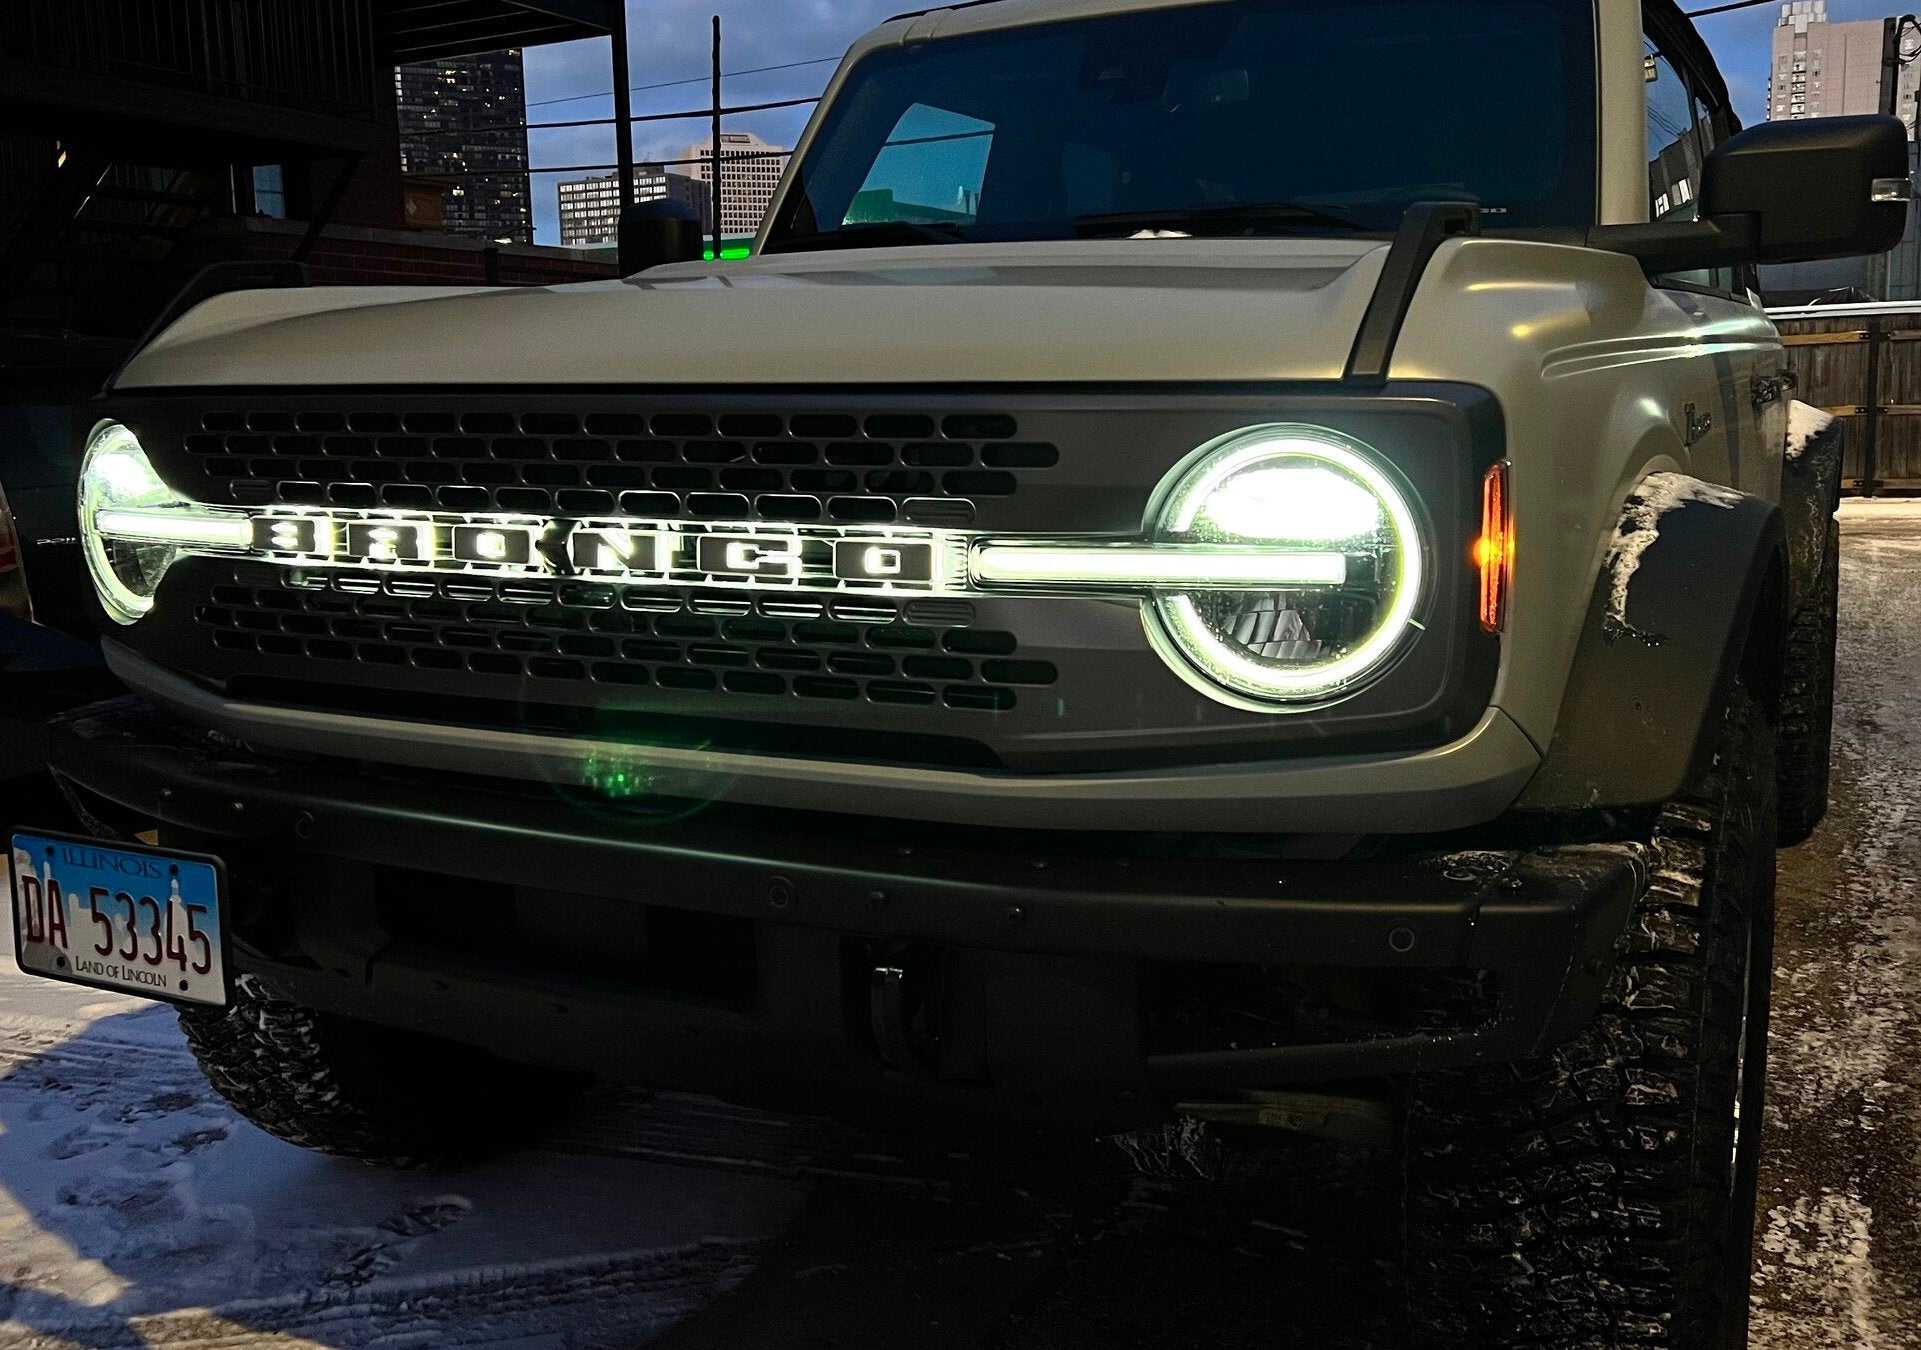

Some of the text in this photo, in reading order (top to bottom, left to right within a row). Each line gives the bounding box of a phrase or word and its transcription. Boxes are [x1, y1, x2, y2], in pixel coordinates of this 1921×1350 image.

[251, 515, 936, 584] BRONCO
[62, 847, 163, 879] ILLINOIS
[22, 875, 211, 975] DA 53345
